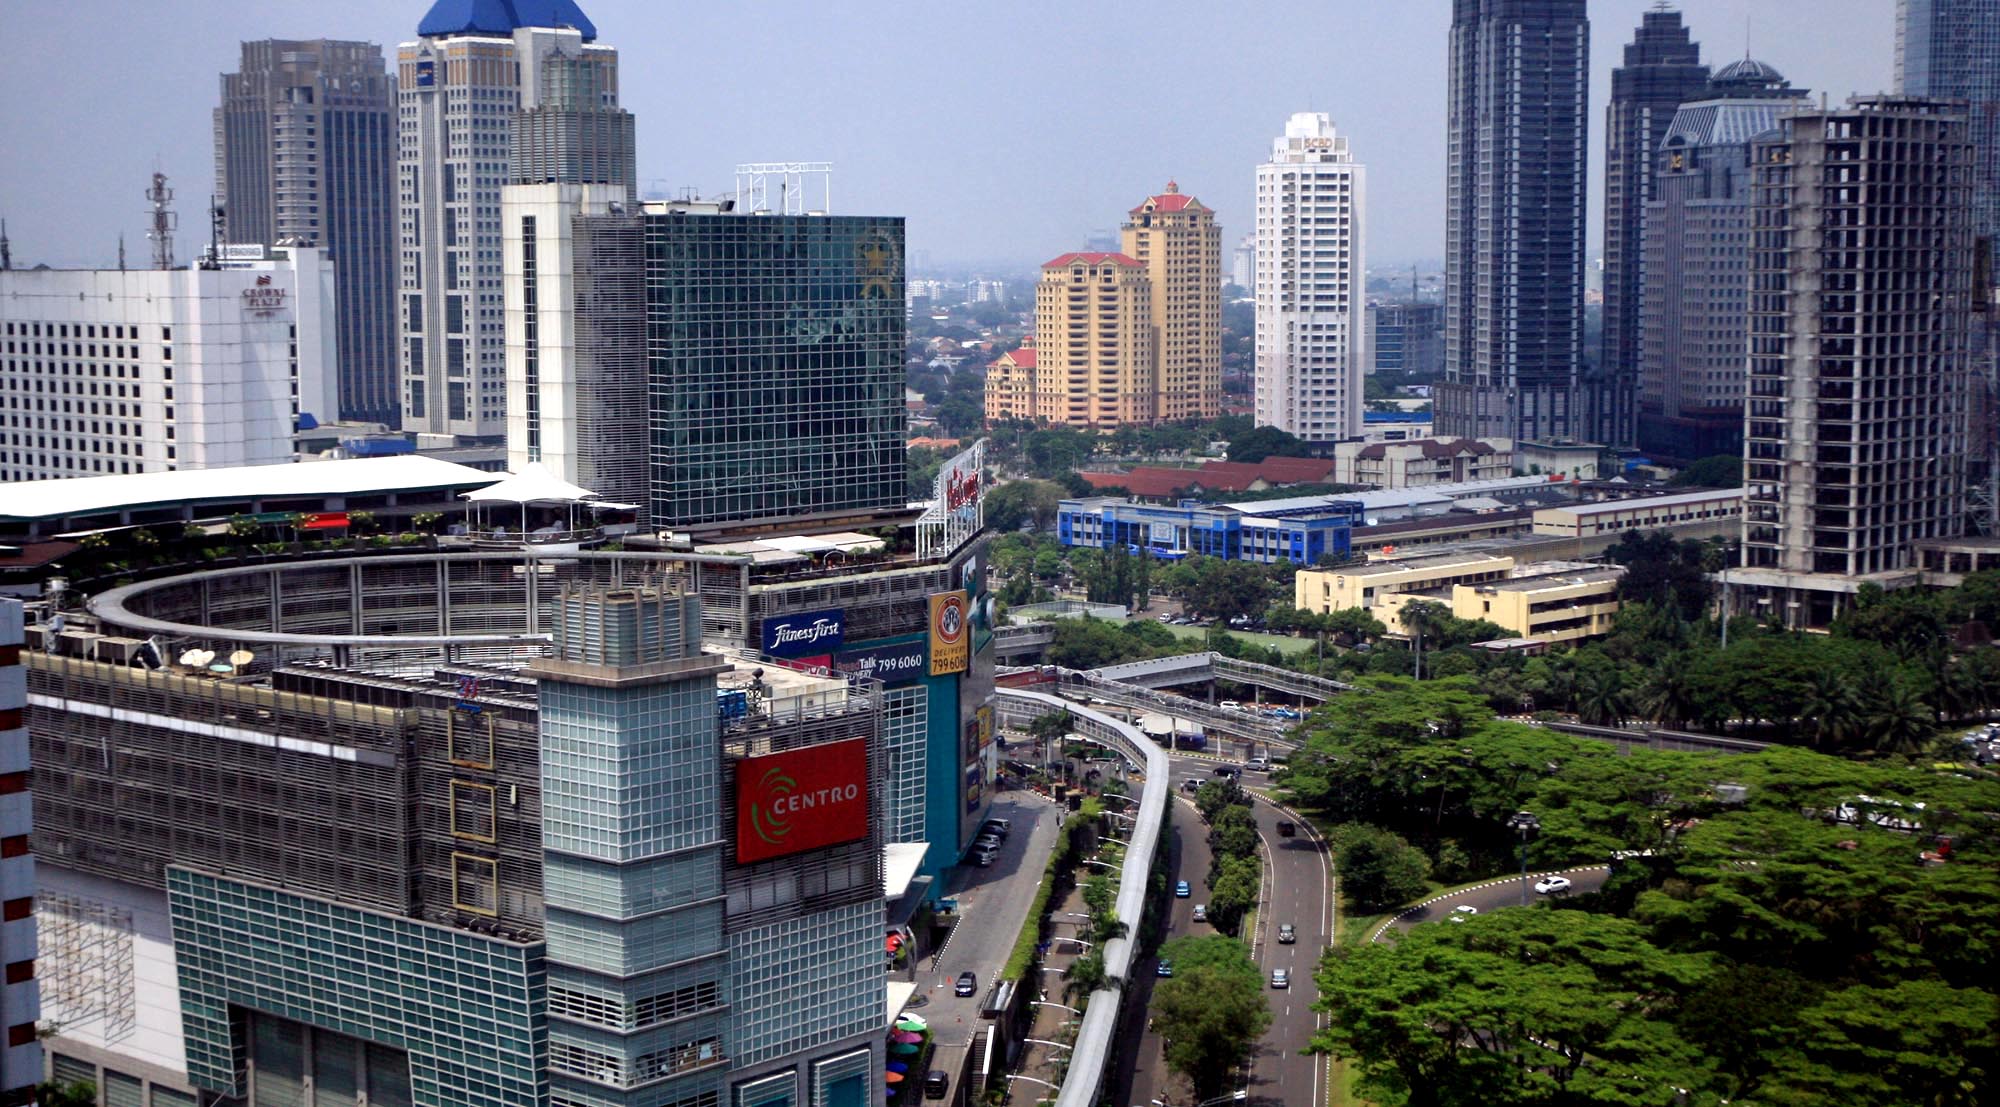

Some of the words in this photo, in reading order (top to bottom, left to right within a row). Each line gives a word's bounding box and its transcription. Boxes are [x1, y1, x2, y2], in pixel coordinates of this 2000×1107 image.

[1304, 137, 1333, 148] SCBD
[242, 288, 286, 298] CROWNE
[249, 297, 281, 307] PLAZA
[770, 623, 813, 649] Fitness
[808, 618, 839, 643] First
[773, 783, 858, 815] CENTRO
